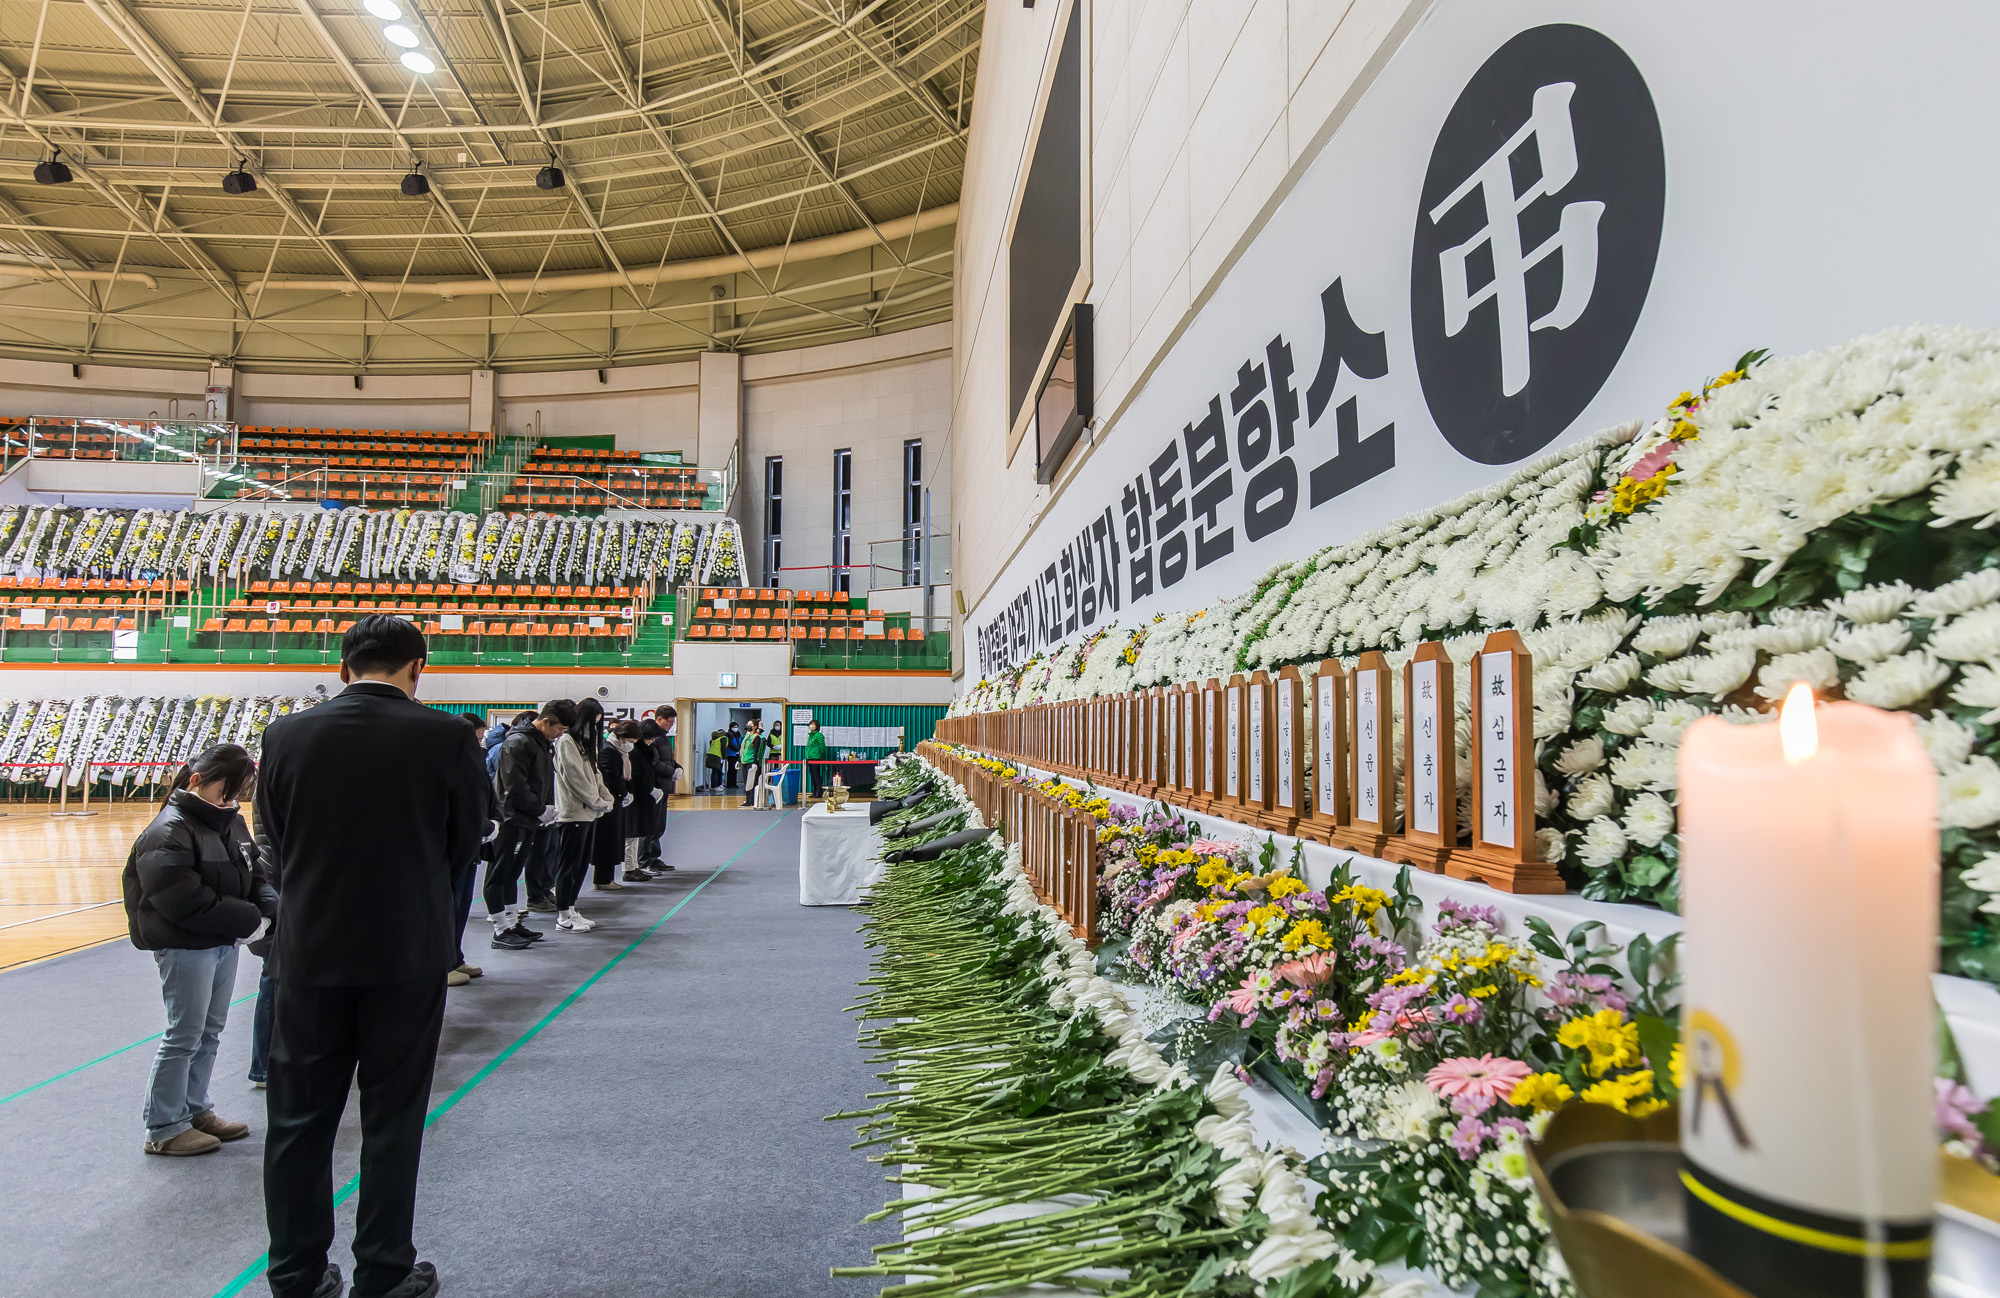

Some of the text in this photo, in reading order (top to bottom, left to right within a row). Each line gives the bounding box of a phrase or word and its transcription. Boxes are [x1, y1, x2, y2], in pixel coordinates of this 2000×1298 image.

[1429, 81, 1606, 398] 弔
[1008, 585, 1034, 663] 여객기
[1121, 276, 1396, 604] 합동분향소
